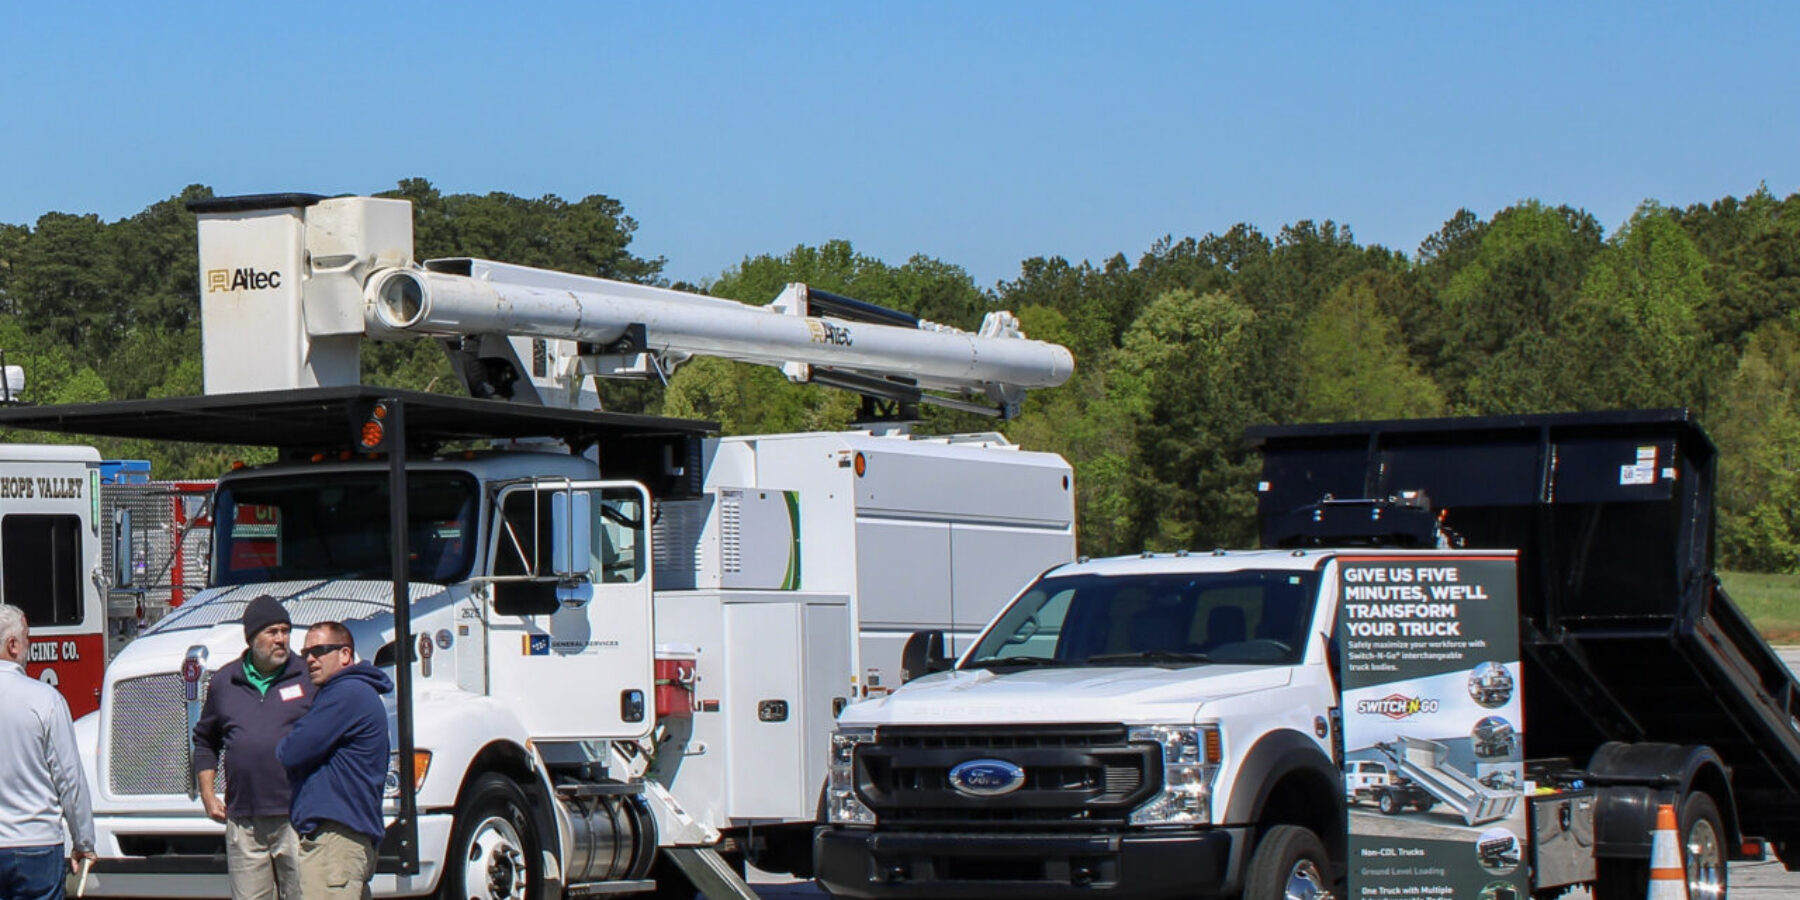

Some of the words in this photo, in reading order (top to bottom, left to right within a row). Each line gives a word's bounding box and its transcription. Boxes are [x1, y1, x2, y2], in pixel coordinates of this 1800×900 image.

[231, 268, 281, 291] Altec
[0, 476, 34, 498] HOPE
[37, 477, 83, 498] VALLEY
[1343, 567, 1387, 582] GIVE
[1389, 567, 1413, 582] US
[1416, 567, 1459, 582] FIVE
[1344, 585, 1428, 602] MINUTES,
[1430, 584, 1488, 600] WE'LL
[1345, 604, 1457, 619] TRANSFORM
[1346, 622, 1397, 637] YOUR
[1399, 621, 1462, 637] TRUCK
[27, 641, 58, 660] GINE
[62, 641, 79, 660] CO.
[1348, 641, 1371, 650] Safely
[1373, 640, 1408, 649] maximize
[1410, 642, 1427, 650] your
[1428, 640, 1467, 649] workforce
[1468, 639, 1486, 648] with
[1349, 663, 1369, 671] truck
[1361, 847, 1397, 857] Non-CDL
[1398, 847, 1425, 857] Trucks
[1361, 866, 1390, 876] Ground
[1391, 866, 1413, 876] Level
[1414, 866, 1445, 877] Loading
[1361, 886, 1377, 895] One
[1379, 886, 1401, 895] Truck
[1402, 886, 1420, 895] with
[1421, 885, 1454, 896] Multiple
